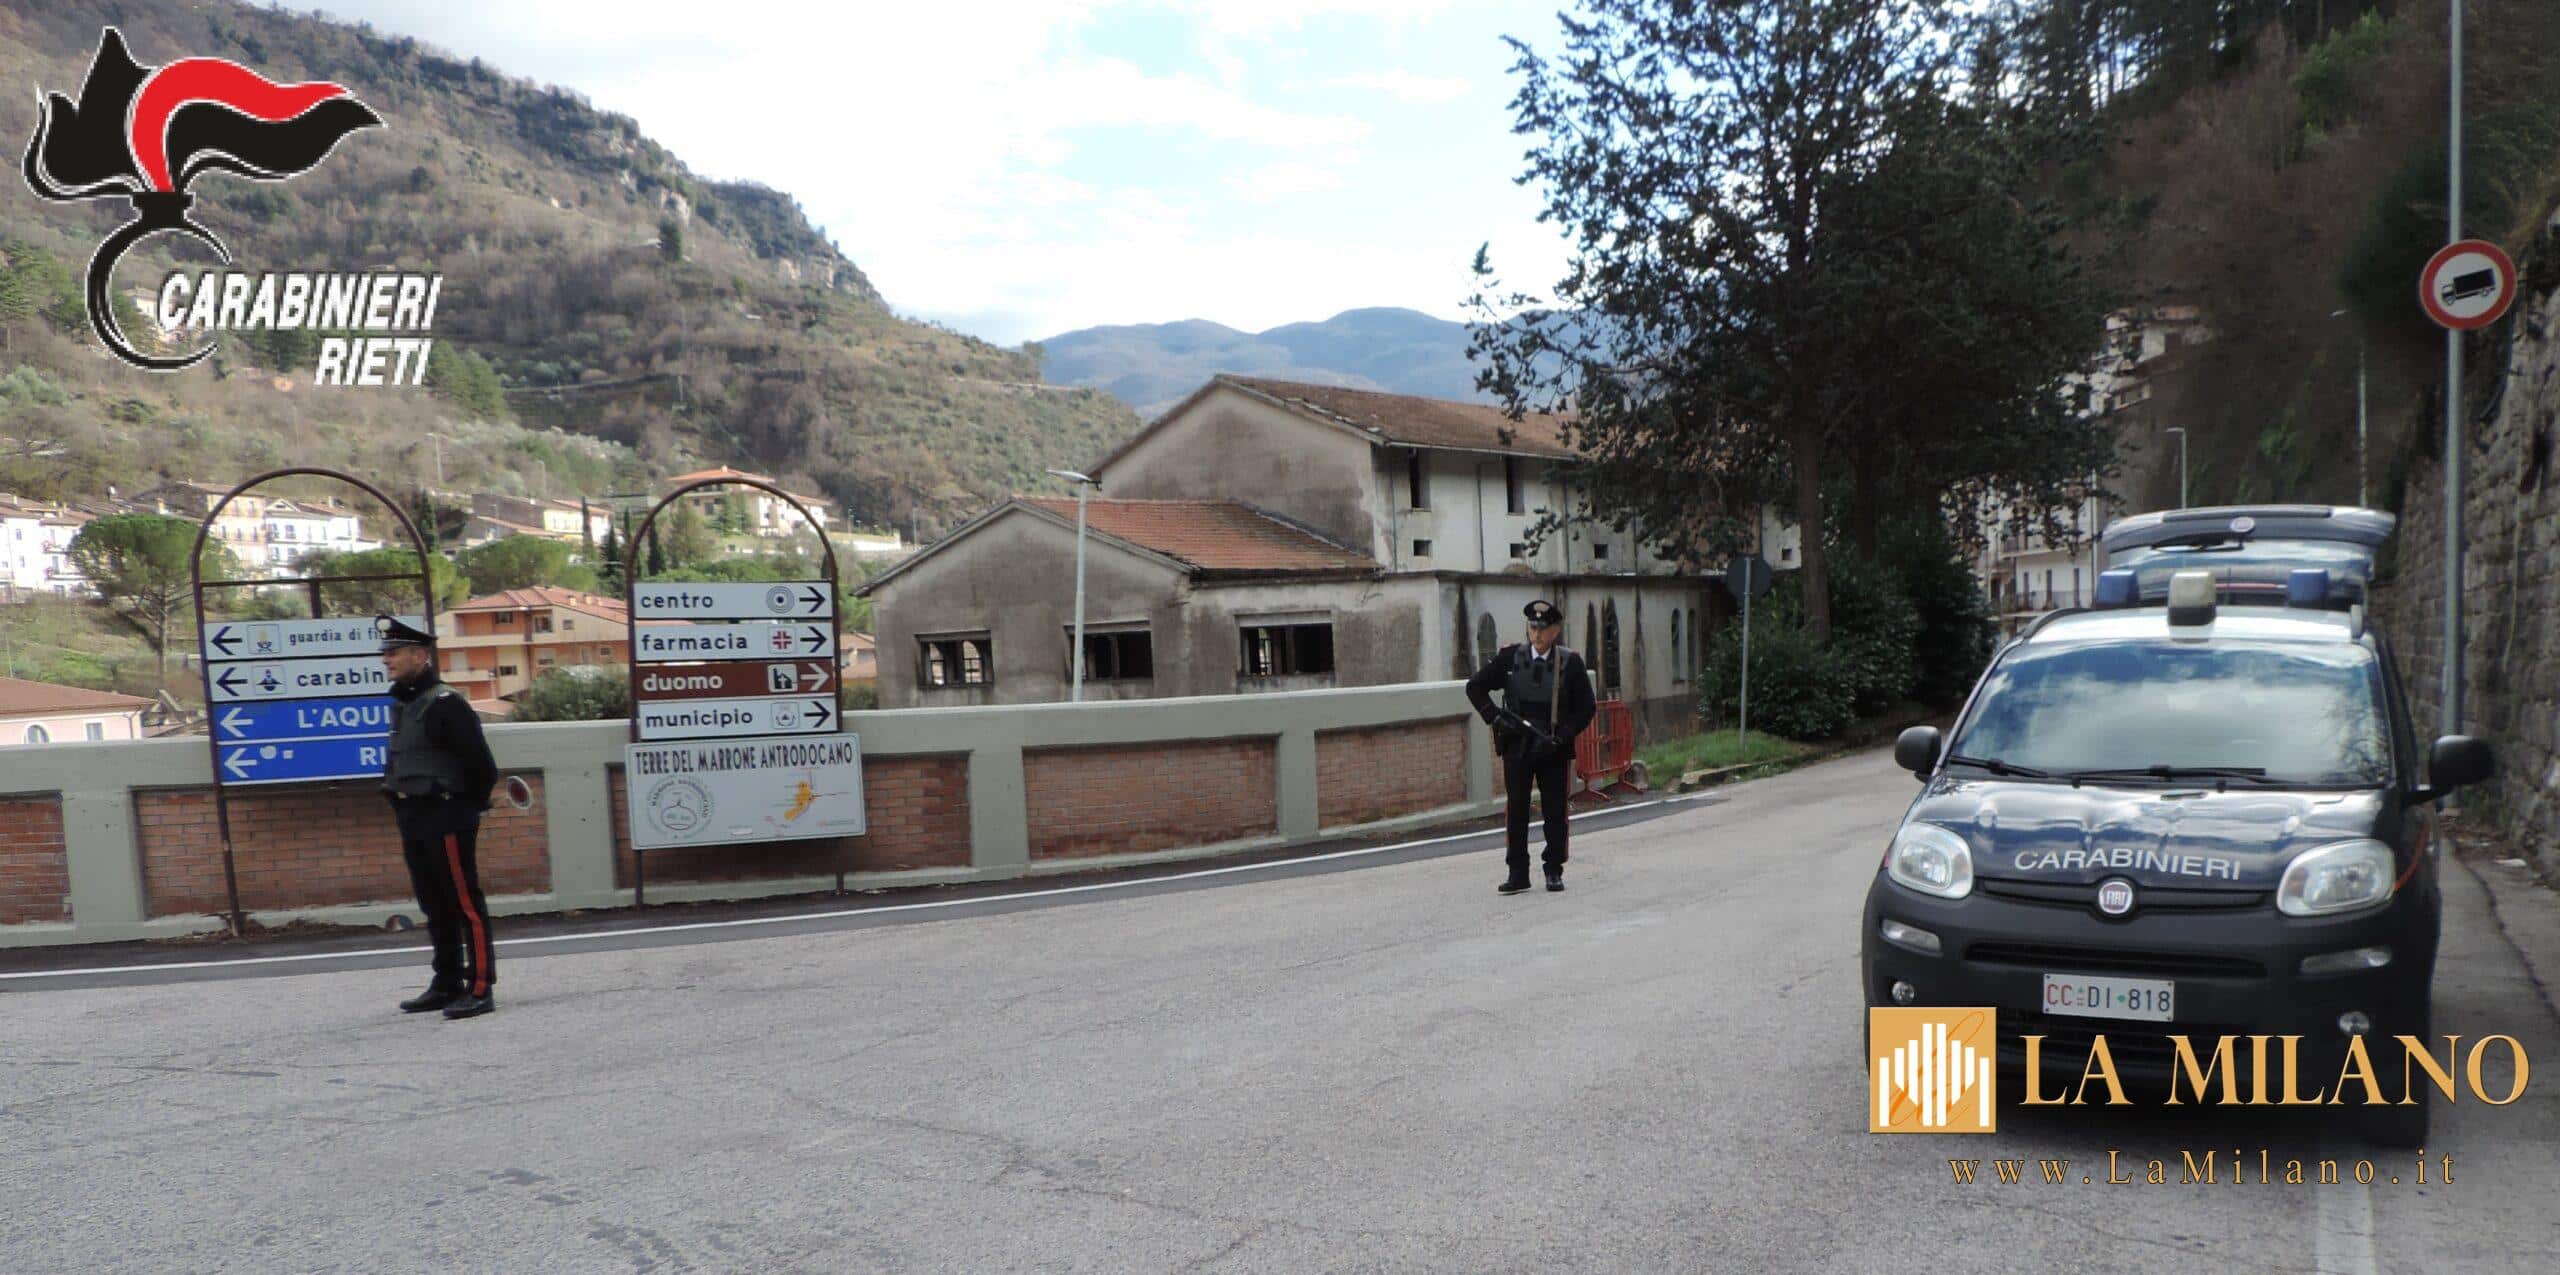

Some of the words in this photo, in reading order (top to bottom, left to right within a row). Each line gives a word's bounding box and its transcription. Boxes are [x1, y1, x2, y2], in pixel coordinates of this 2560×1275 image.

[641, 592, 713, 608] centro
[289, 629, 342, 646] guardia
[349, 628, 360, 640] di
[642, 633, 748, 651] farmacia
[296, 667, 391, 687] carabin
[643, 673, 723, 691] duomo
[298, 705, 391, 728] L'AQUI
[646, 709, 753, 728] municipio
[360, 746, 387, 766] RI
[635, 750, 670, 775] TERRE
[672, 749, 694, 773] DEL
[698, 746, 756, 772] MARRONE
[760, 742, 853, 769] ANTRODOCANO
[2014, 847, 2241, 881] CARABINIERI
[2047, 983, 2073, 1006] CC
[2088, 986, 2111, 1008] DI
[2128, 988, 2171, 1012] 818
